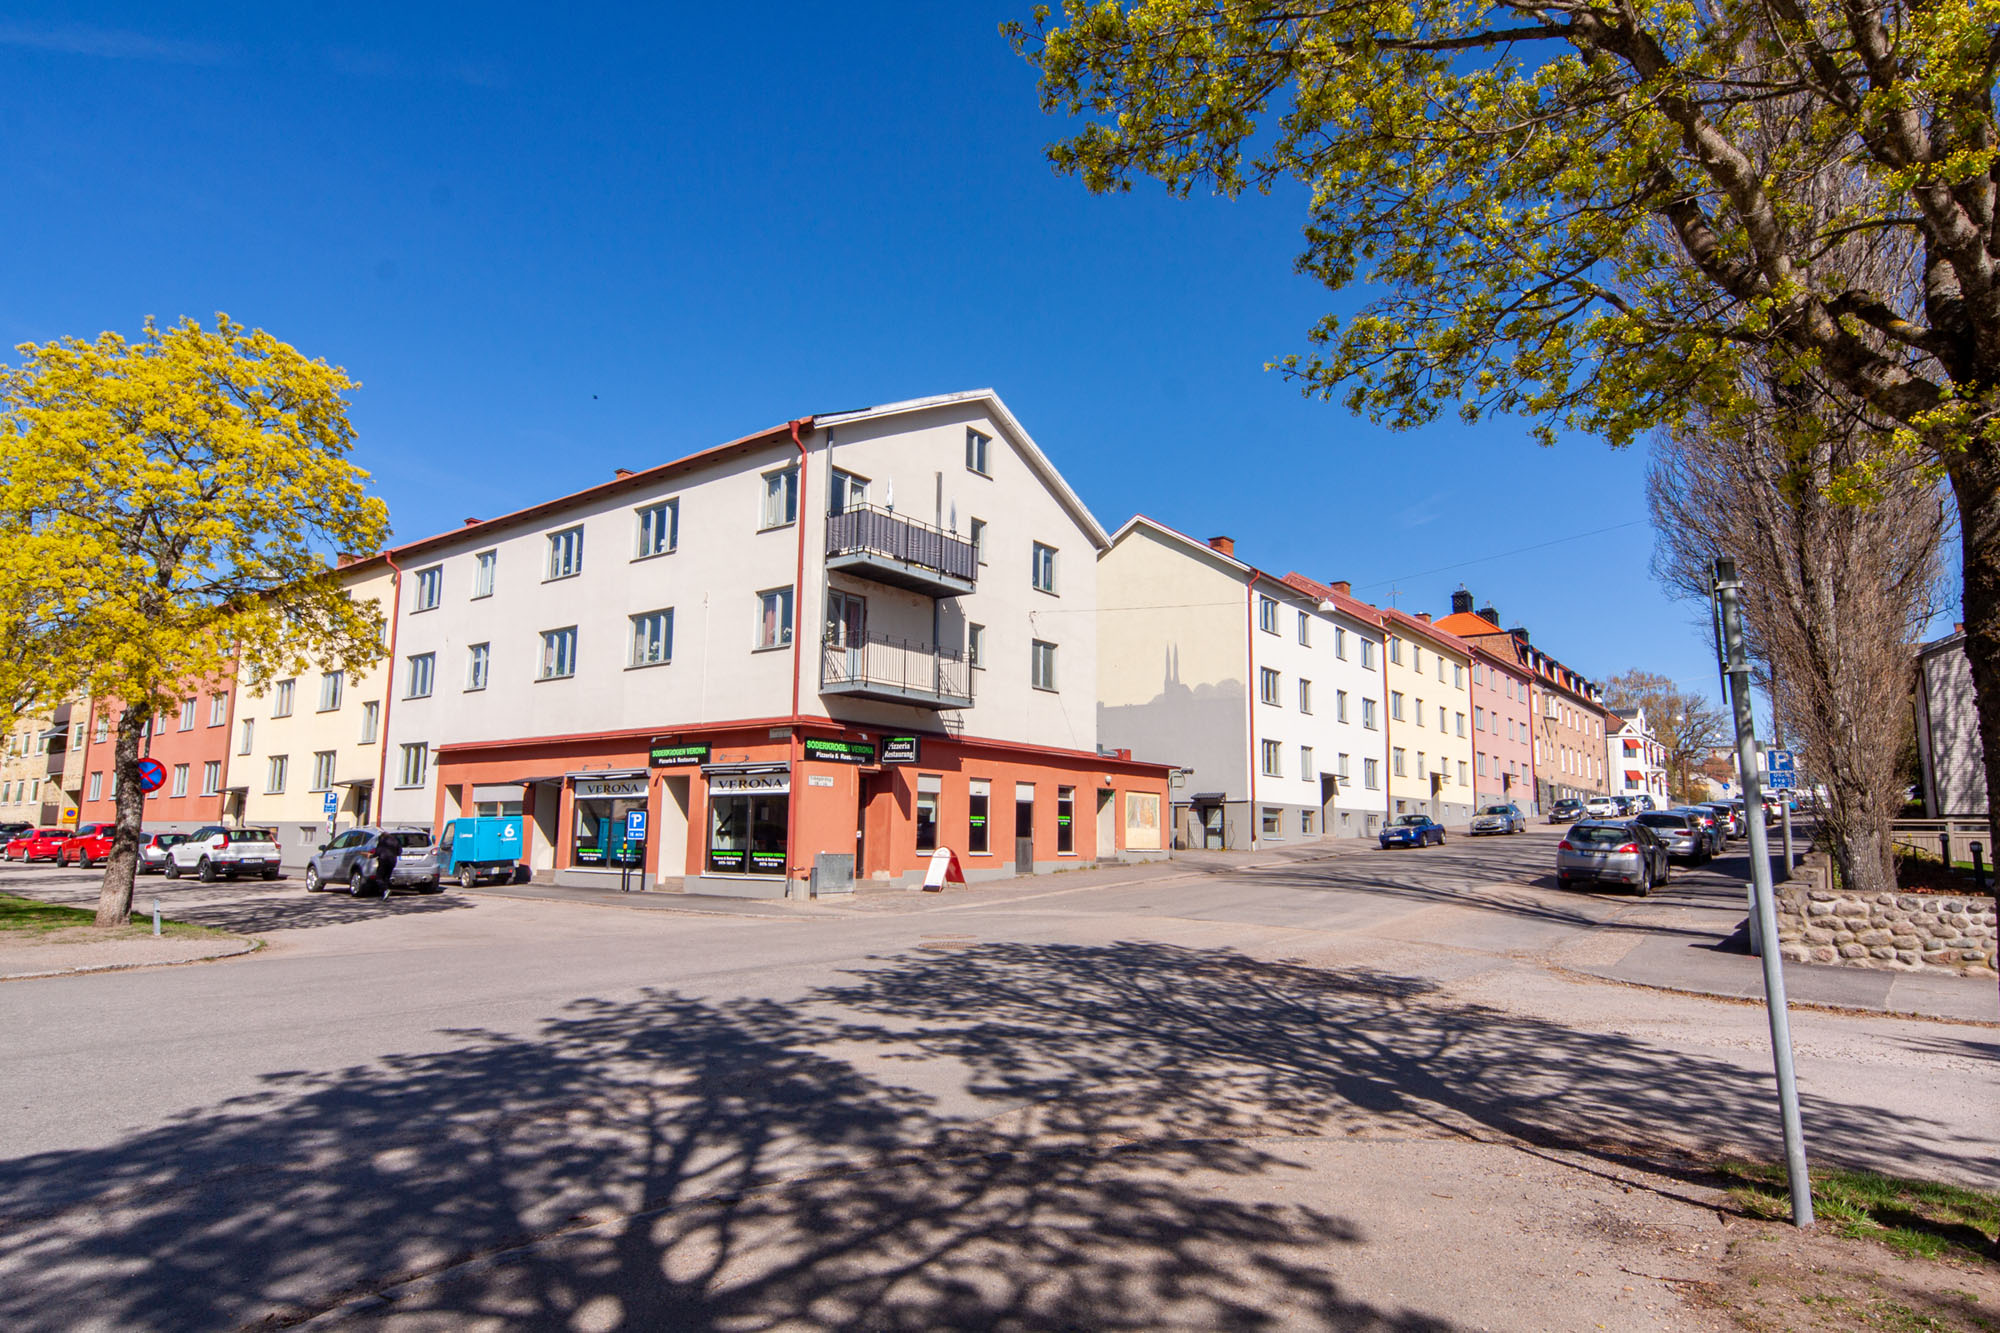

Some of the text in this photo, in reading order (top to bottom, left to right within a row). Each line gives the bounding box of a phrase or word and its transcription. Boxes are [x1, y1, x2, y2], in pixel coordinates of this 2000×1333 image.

[851, 744, 874, 754] VERONA
[1775, 752, 1789, 769] P
[587, 783, 640, 793] VERONA
[718, 778, 783, 789] VERONA
[328, 793, 336, 803] P
[631, 814, 642, 827] P
[504, 823, 515, 837] 6
